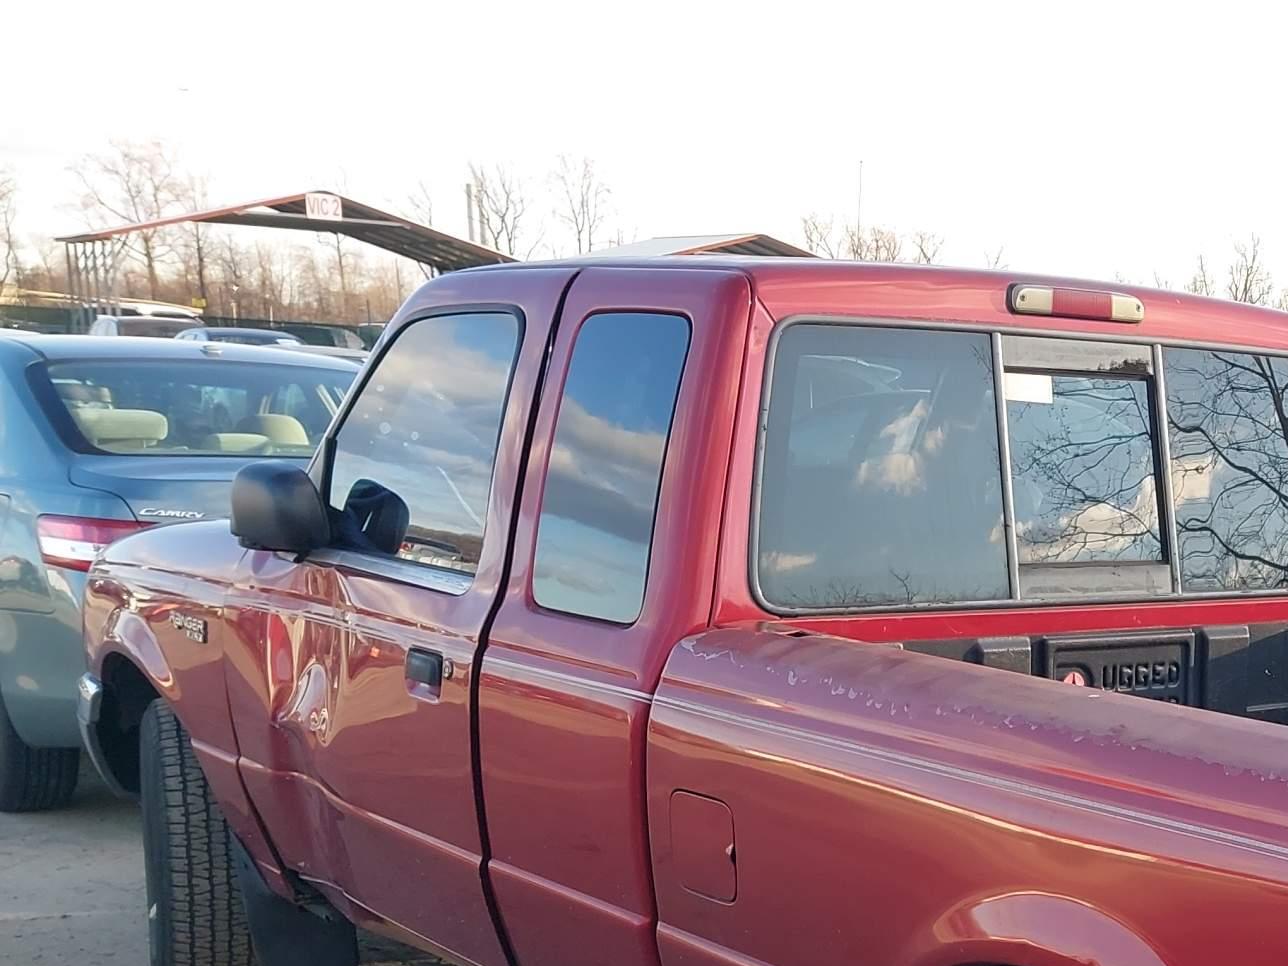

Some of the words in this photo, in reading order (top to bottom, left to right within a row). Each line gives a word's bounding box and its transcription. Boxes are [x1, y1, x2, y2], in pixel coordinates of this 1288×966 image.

[307, 196, 328, 216] VIC
[332, 198, 341, 217] 2
[169, 610, 204, 634] RANGER
